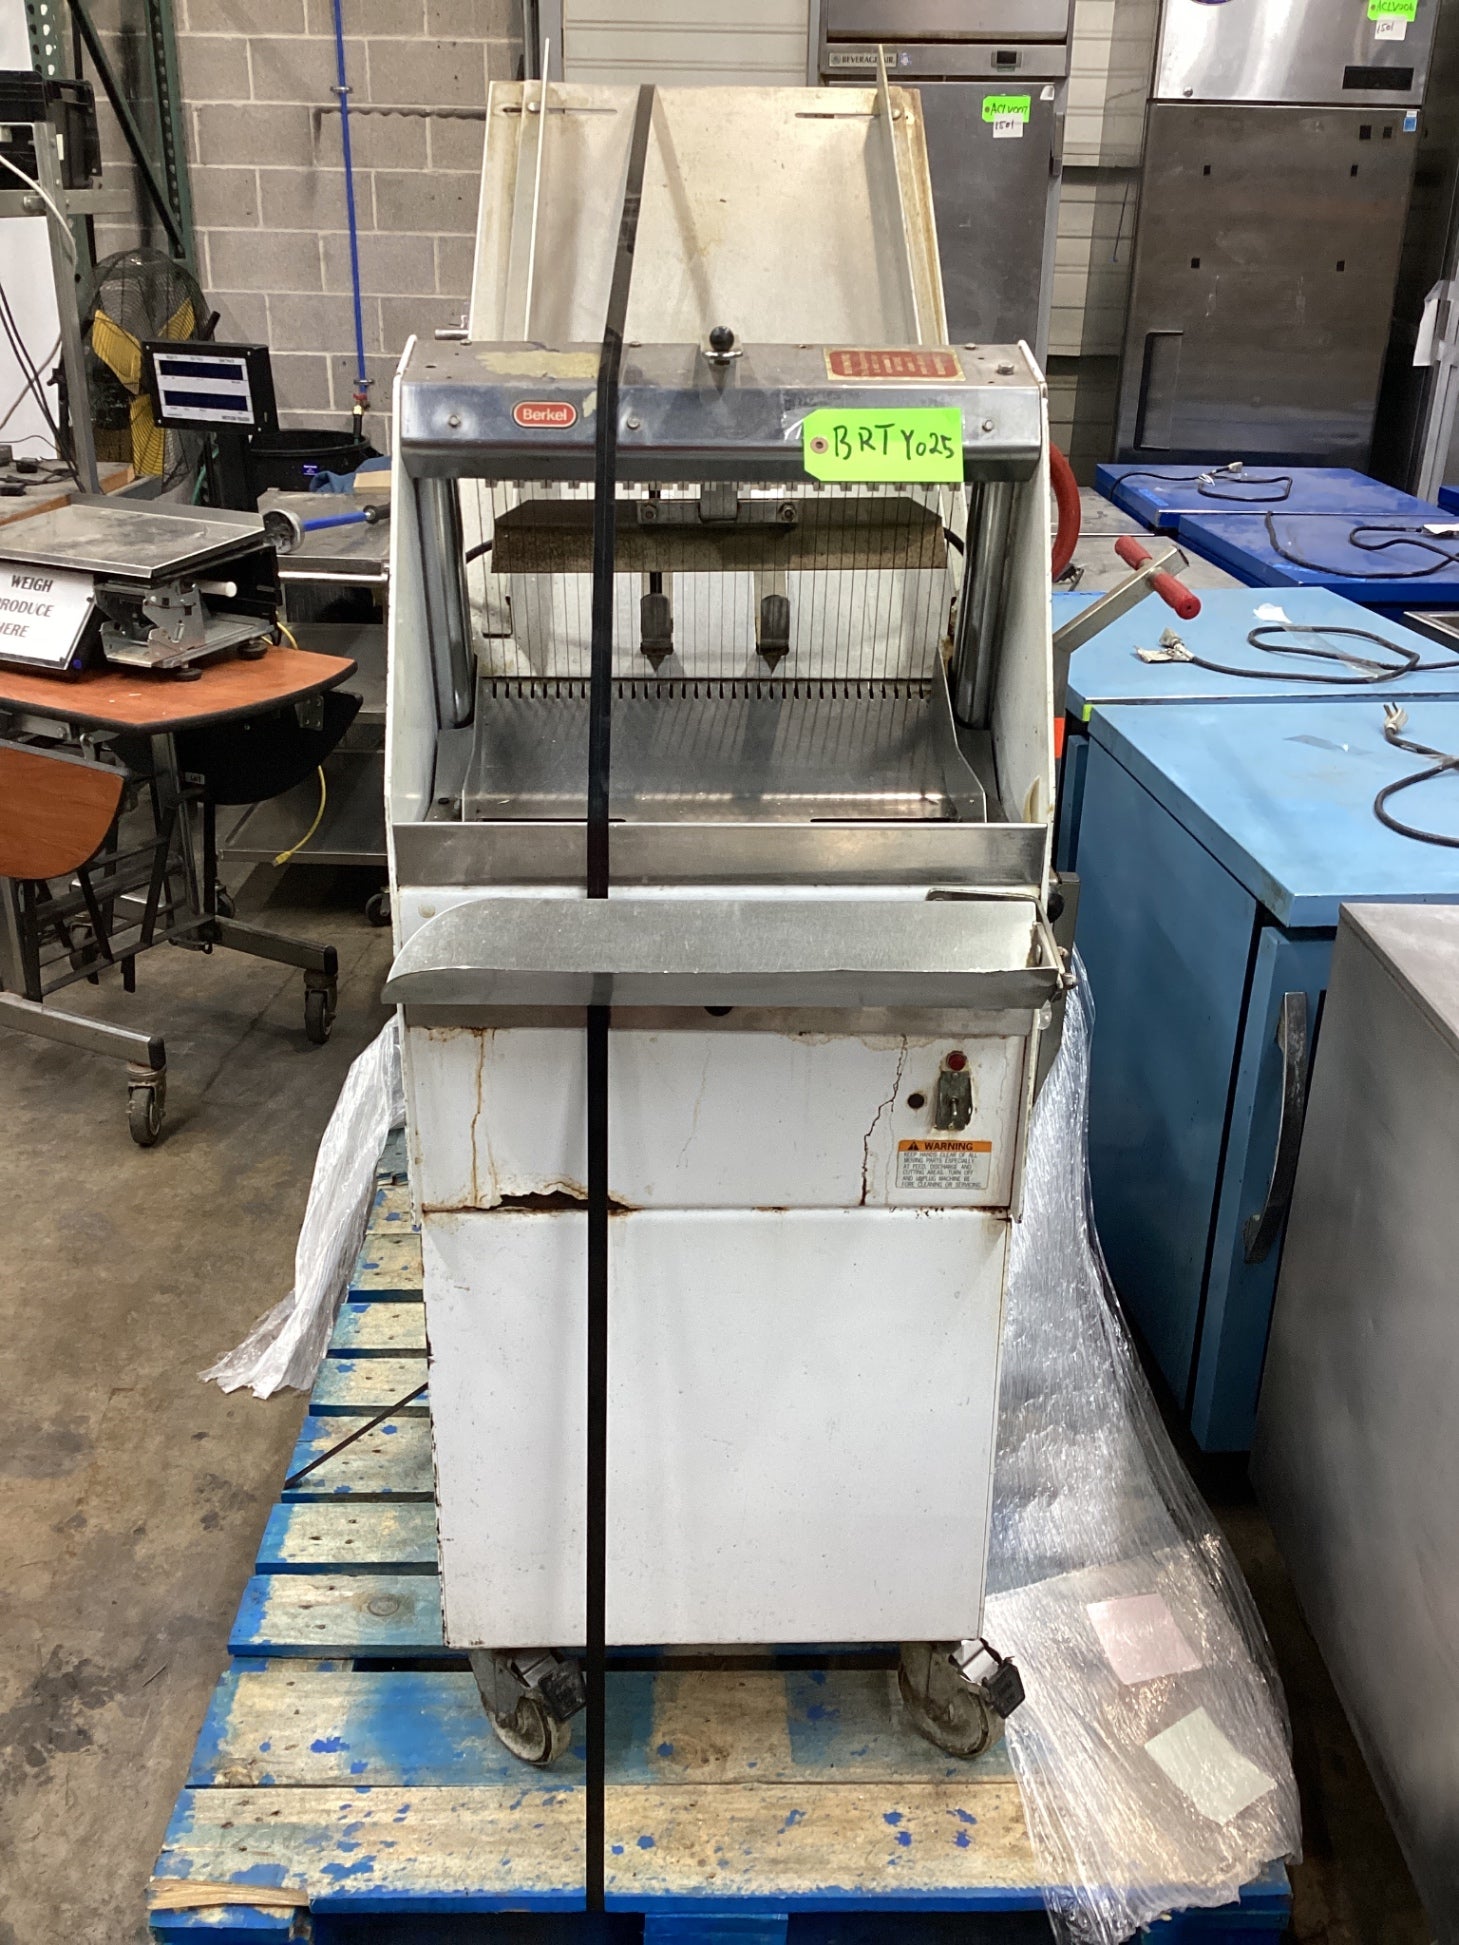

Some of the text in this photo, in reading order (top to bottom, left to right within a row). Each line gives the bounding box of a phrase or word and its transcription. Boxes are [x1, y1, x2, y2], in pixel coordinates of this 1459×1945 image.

[522, 408, 568, 421] Berkel
[11, 574, 54, 593] WEIGH
[0, 597, 54, 617] RODUCE
[924, 1142, 974, 1151] WARNING
